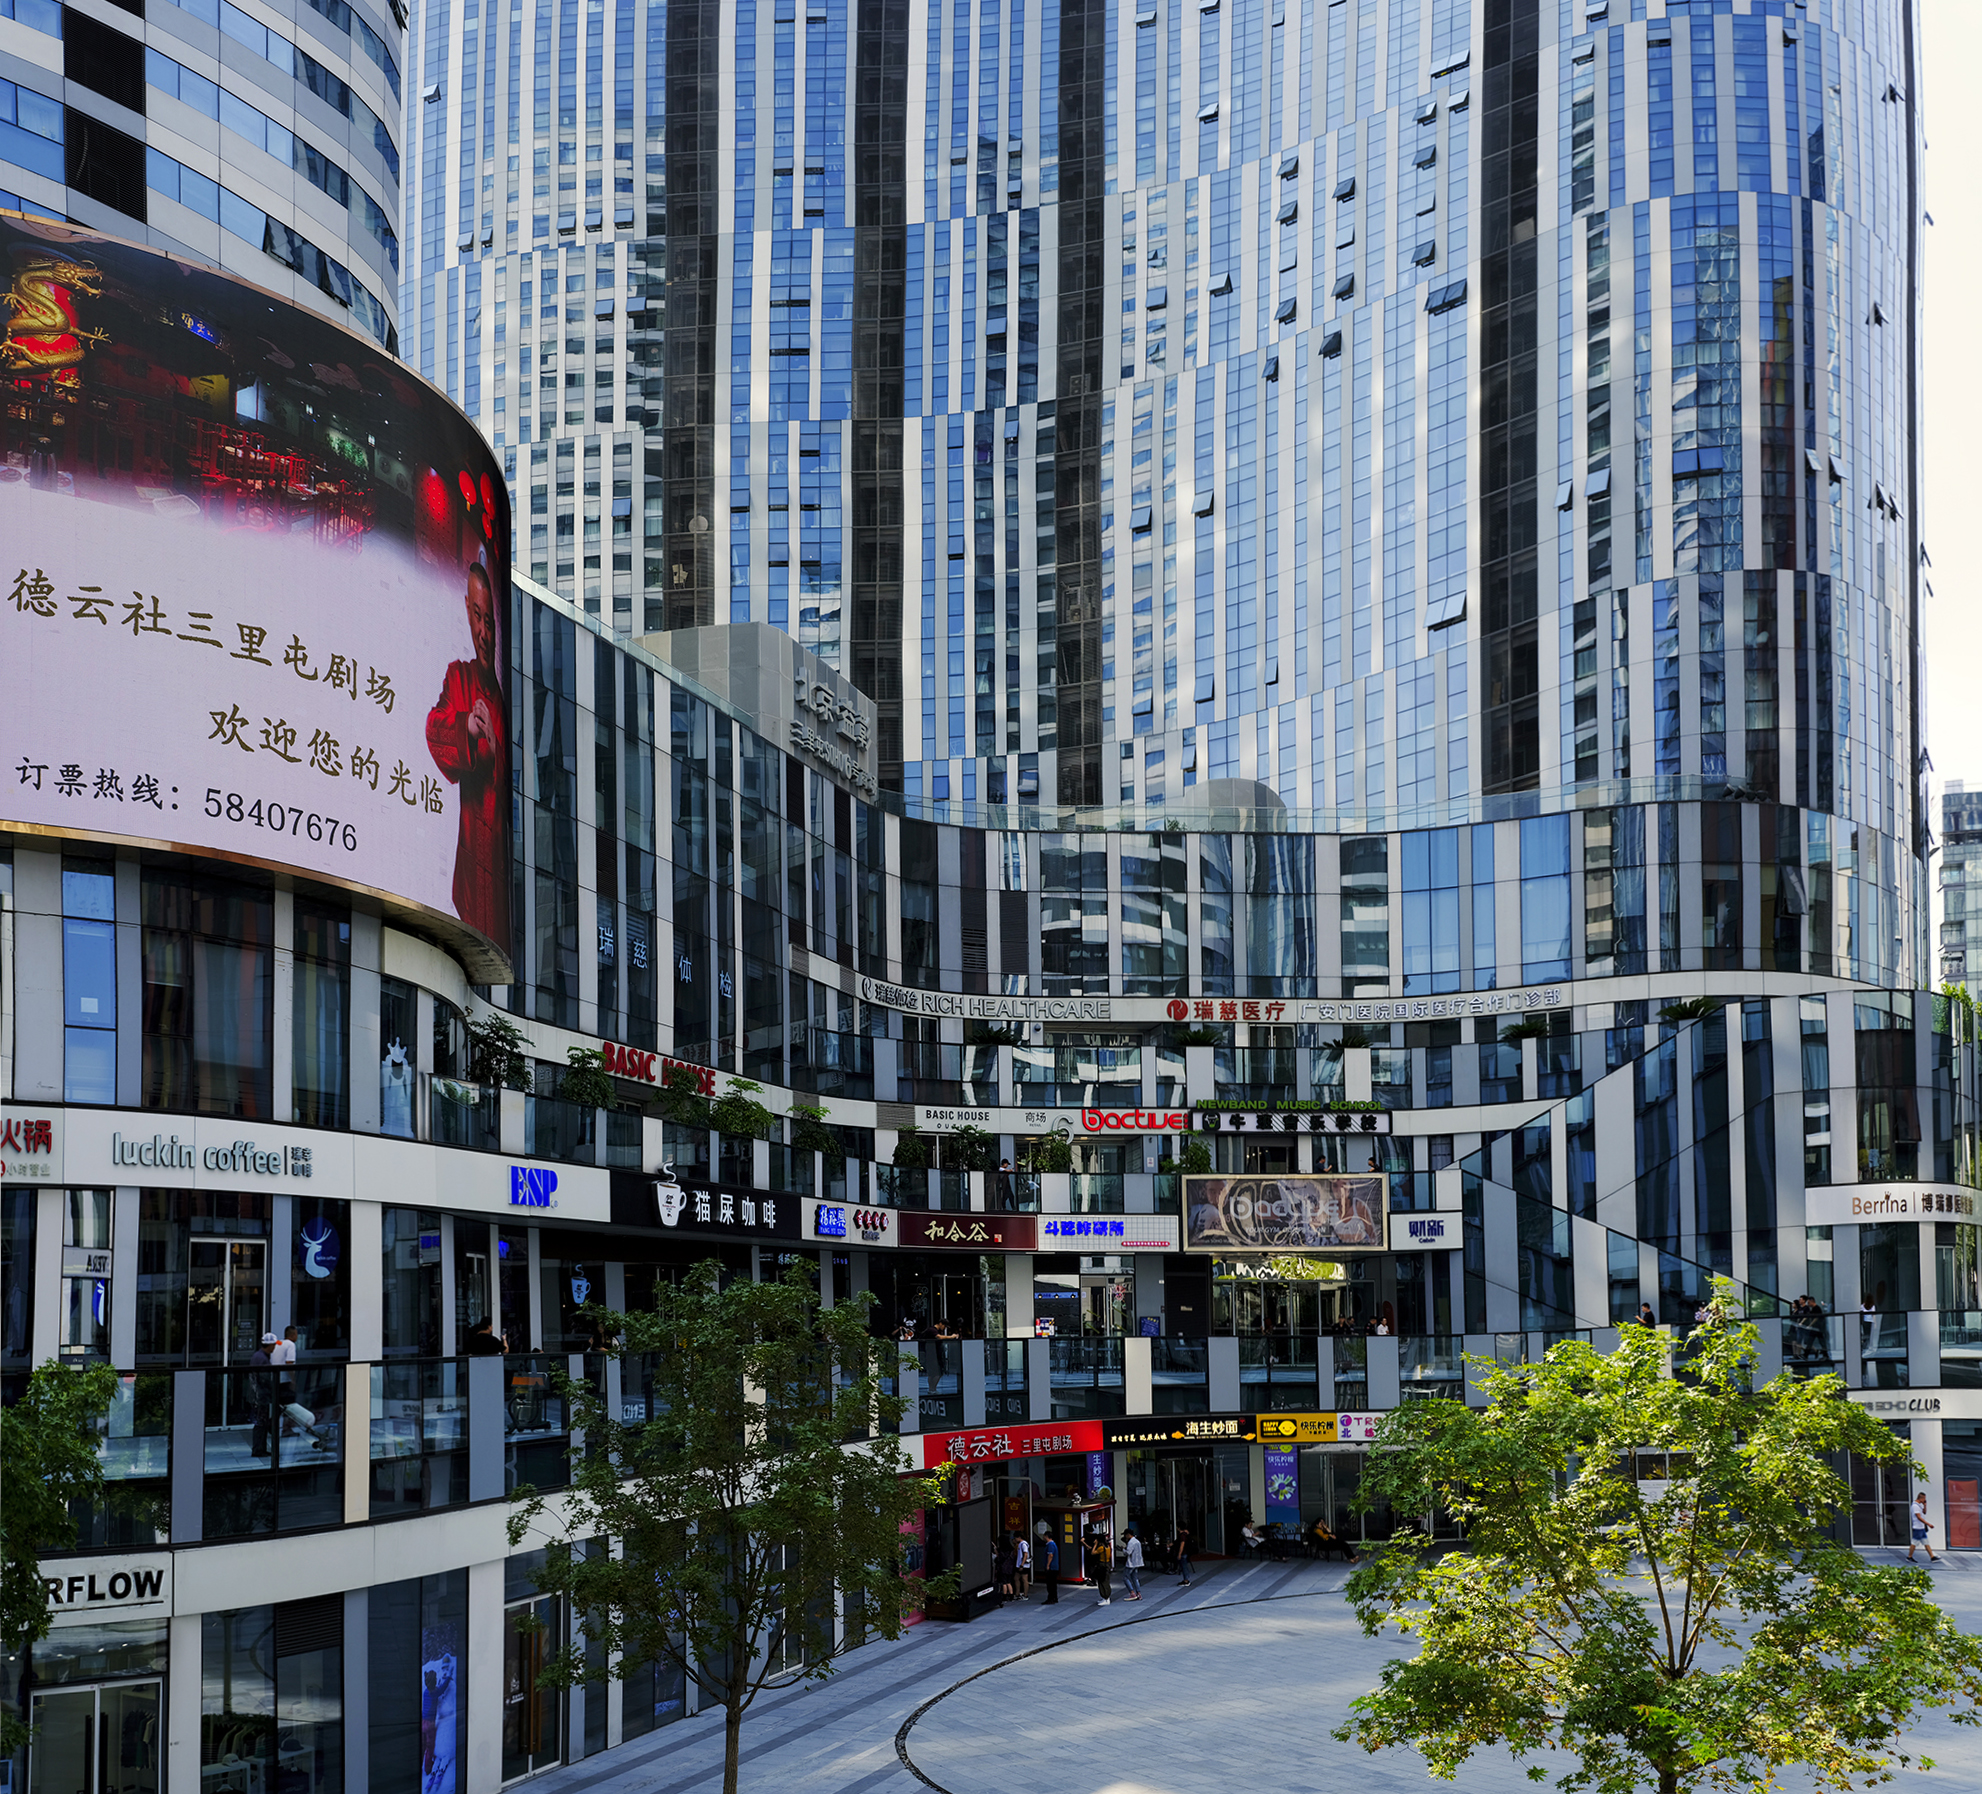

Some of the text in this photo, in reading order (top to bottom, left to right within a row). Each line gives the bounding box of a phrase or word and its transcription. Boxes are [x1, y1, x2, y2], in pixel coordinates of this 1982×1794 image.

[8, 568, 397, 715] 德云社三里屯剧场
[208, 703, 445, 815] 欢迎您的光临
[204, 788, 359, 852] 58407676
[598, 926, 733, 999] 瑞慈体检
[921, 993, 964, 1016] RICH
[969, 998, 1111, 1020] HEALTHCARE
[1193, 1000, 1286, 1021] 瑞慈医疗
[1301, 988, 1562, 1021] 广安门医院国际医疗合作门诊部
[603, 1041, 657, 1083] BASIC
[926, 1109, 990, 1121] BASIC HOUSE
[1025, 1112, 1047, 1123] 商场
[1197, 1100, 1385, 1111] NEWBAND MUSIC SCHOOL
[0, 1118, 53, 1154] 火锅
[936, 1122, 979, 1130] OUTLT
[112, 1131, 282, 1175] luckin coffee
[508, 1165, 559, 1207] ESP
[694, 1190, 777, 1230] 猫屎咖啡
[1852, 1191, 1908, 1215] Berrina
[923, 1220, 990, 1242] 和合谷
[1408, 1220, 1444, 1238] 财新
[1909, 1399, 1941, 1412] CLUB
[1186, 1420, 1238, 1436] 海生炒面
[1300, 1420, 1334, 1430] 快乐柠檬
[947, 1433, 1073, 1461] 德云社 三里屯剧场
[43, 1570, 164, 1605] RFLOW
